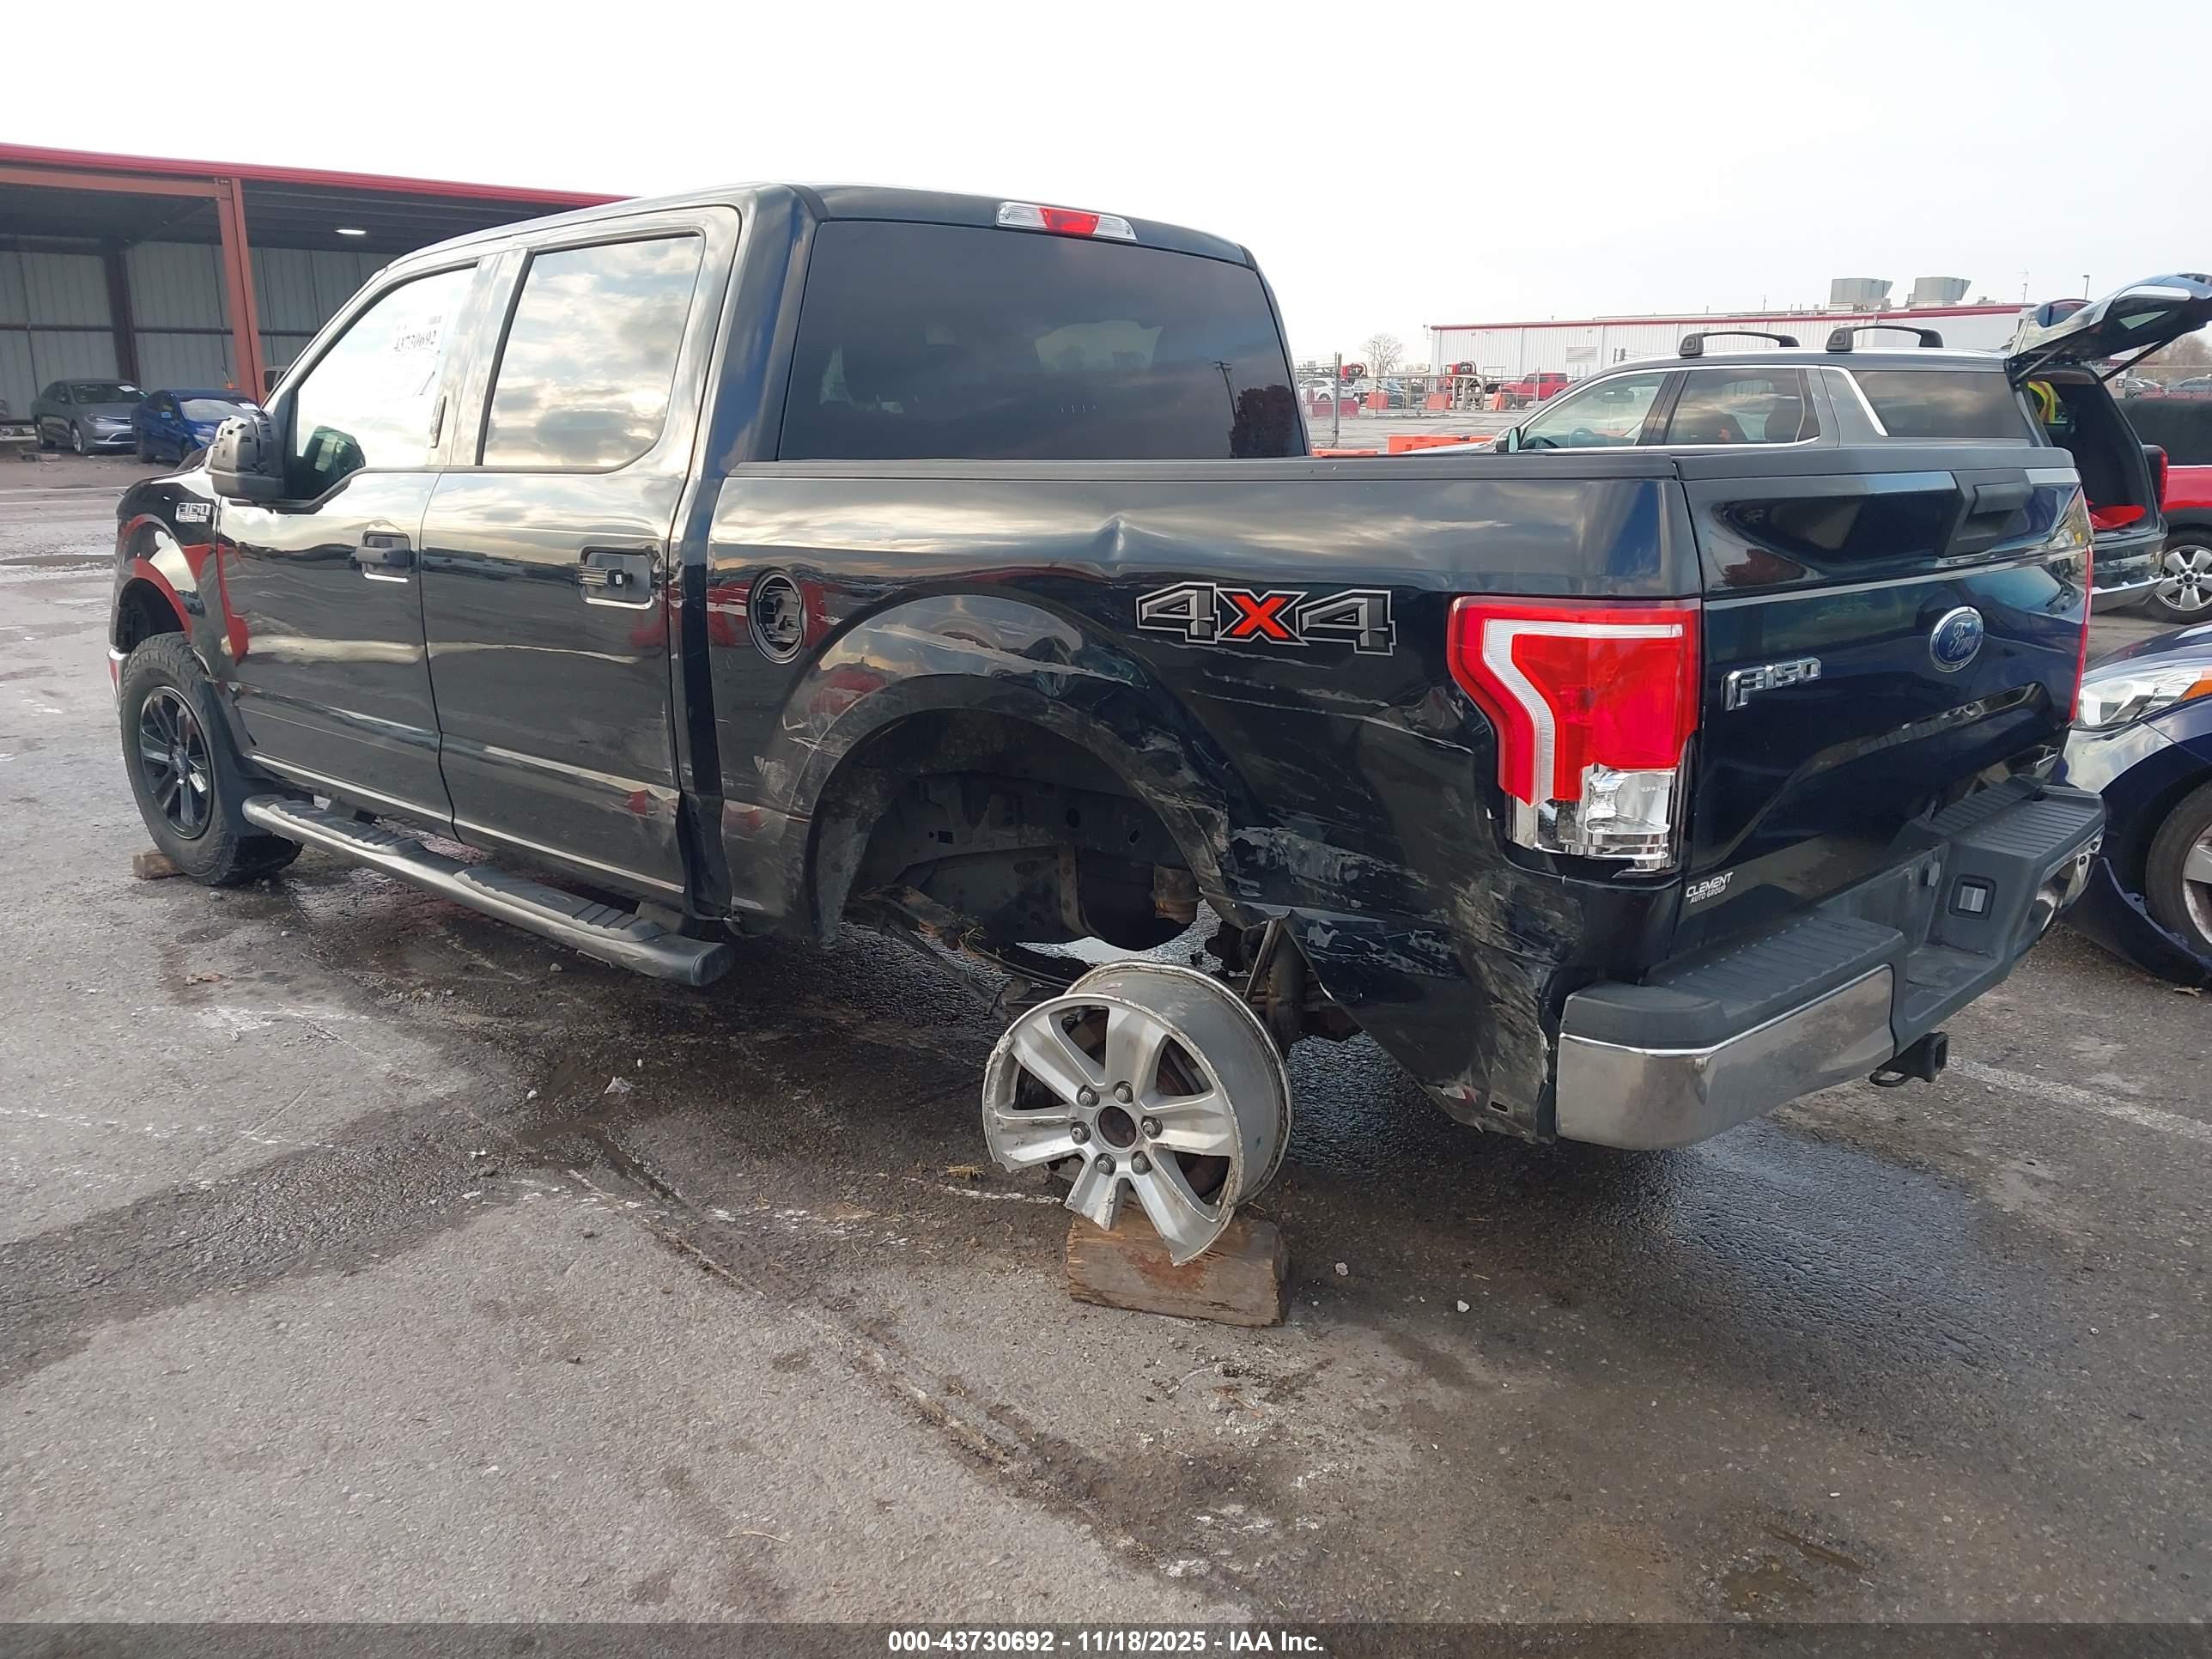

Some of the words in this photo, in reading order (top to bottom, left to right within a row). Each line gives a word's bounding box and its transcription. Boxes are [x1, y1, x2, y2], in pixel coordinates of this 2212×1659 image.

[1947, 622, 1978, 658] Ford
[1686, 872, 1734, 898] CLEMENT
[1689, 891, 1706, 904] AUTO
[1706, 884, 1727, 898] GROUP
